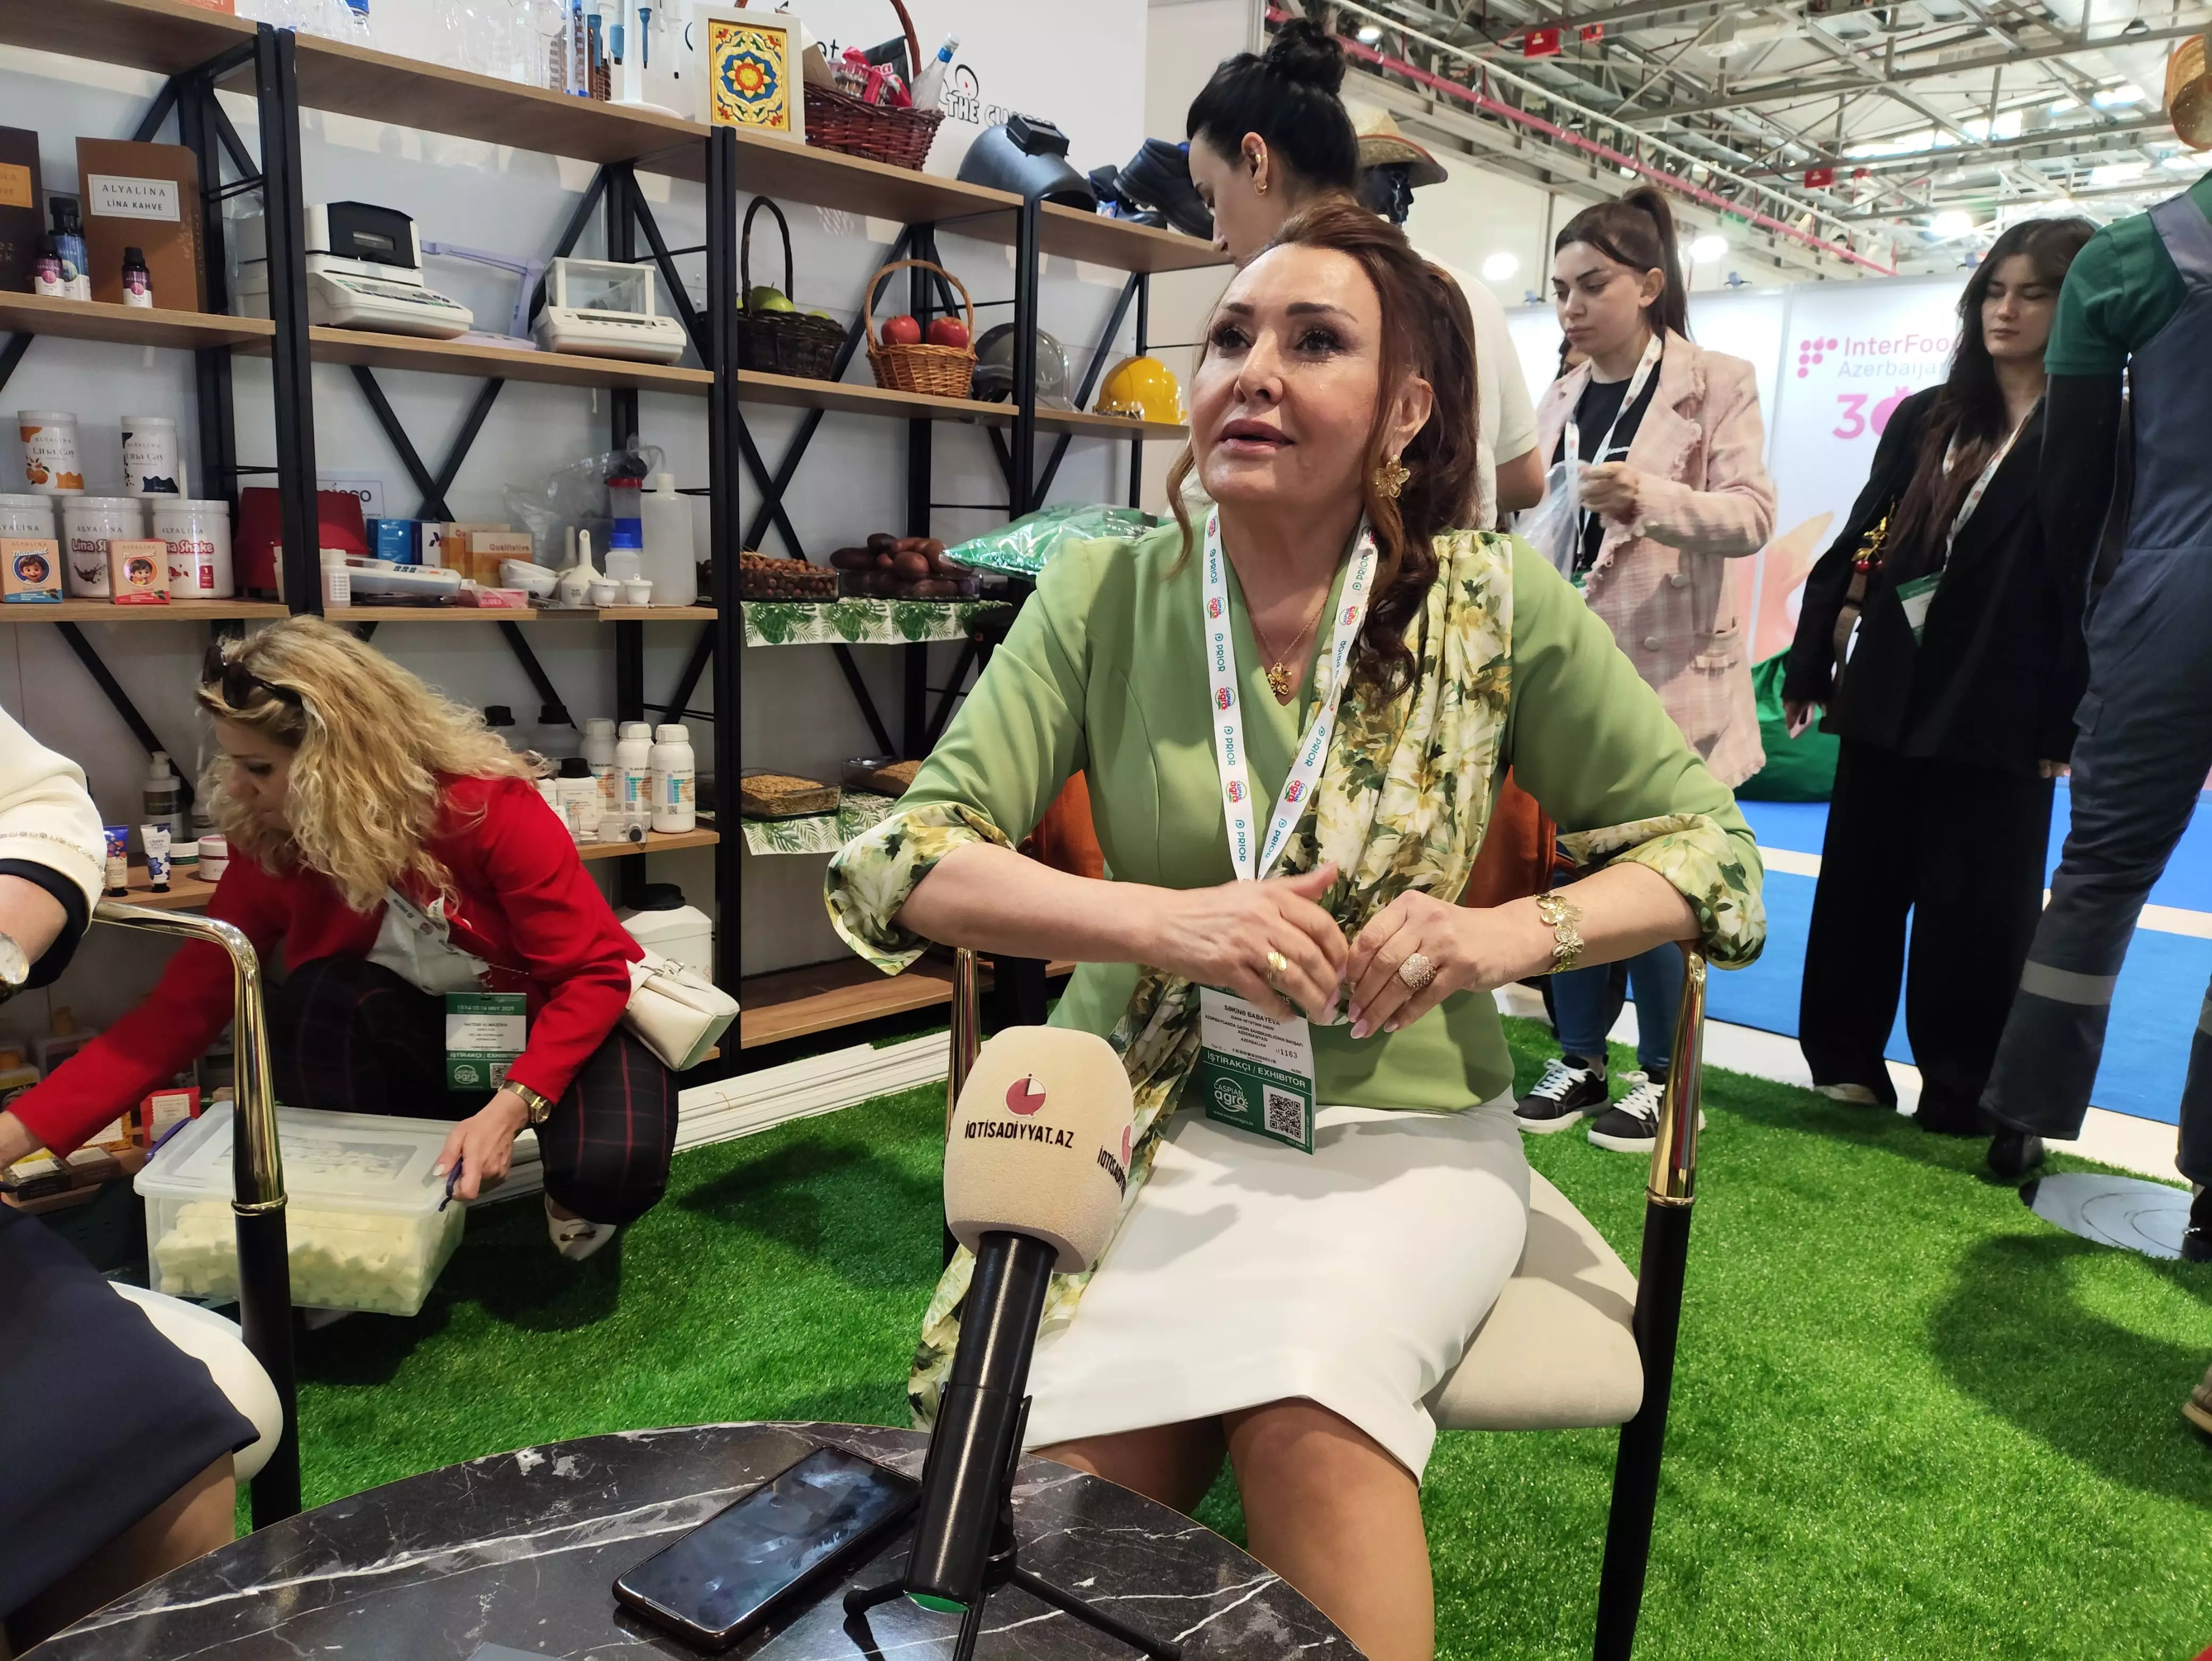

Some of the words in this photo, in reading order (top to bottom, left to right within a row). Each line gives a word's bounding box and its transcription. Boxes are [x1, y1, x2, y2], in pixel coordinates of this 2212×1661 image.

[946, 92, 979, 124] THE
[107, 198, 128, 207] LİNA
[132, 202, 163, 211] KAHVE
[1844, 335, 1959, 357] InterFoo
[71, 538, 95, 553] Lina
[179, 539, 215, 554] Shake
[489, 544, 530, 552] Qualitative
[1356, 555, 1369, 580] PRIOR
[1210, 598, 1219, 619] agro
[1346, 606, 1356, 625] agro
[1216, 644, 1226, 672] PRIOR
[1336, 640, 1347, 670] PRIOR
[1219, 688, 1228, 711] agro
[1225, 738, 1236, 766] PRIOR
[1304, 738, 1321, 767] PRIOR
[1229, 781, 1238, 803] agro
[1287, 780, 1301, 803] agro
[1237, 832, 1246, 862] PRIOR
[1266, 830, 1281, 859] PRIOR
[1247, 1012, 1280, 1026] BABAYEVA
[1207, 1050, 1251, 1072] İŞTİRAKÇI
[1258, 1067, 1306, 1088] EXHIBITOR
[1213, 1082, 1244, 1098] CASPIAN
[1214, 1090, 1246, 1106] agro
[965, 1119, 1074, 1149] İQTİSADİYYAT.AZ
